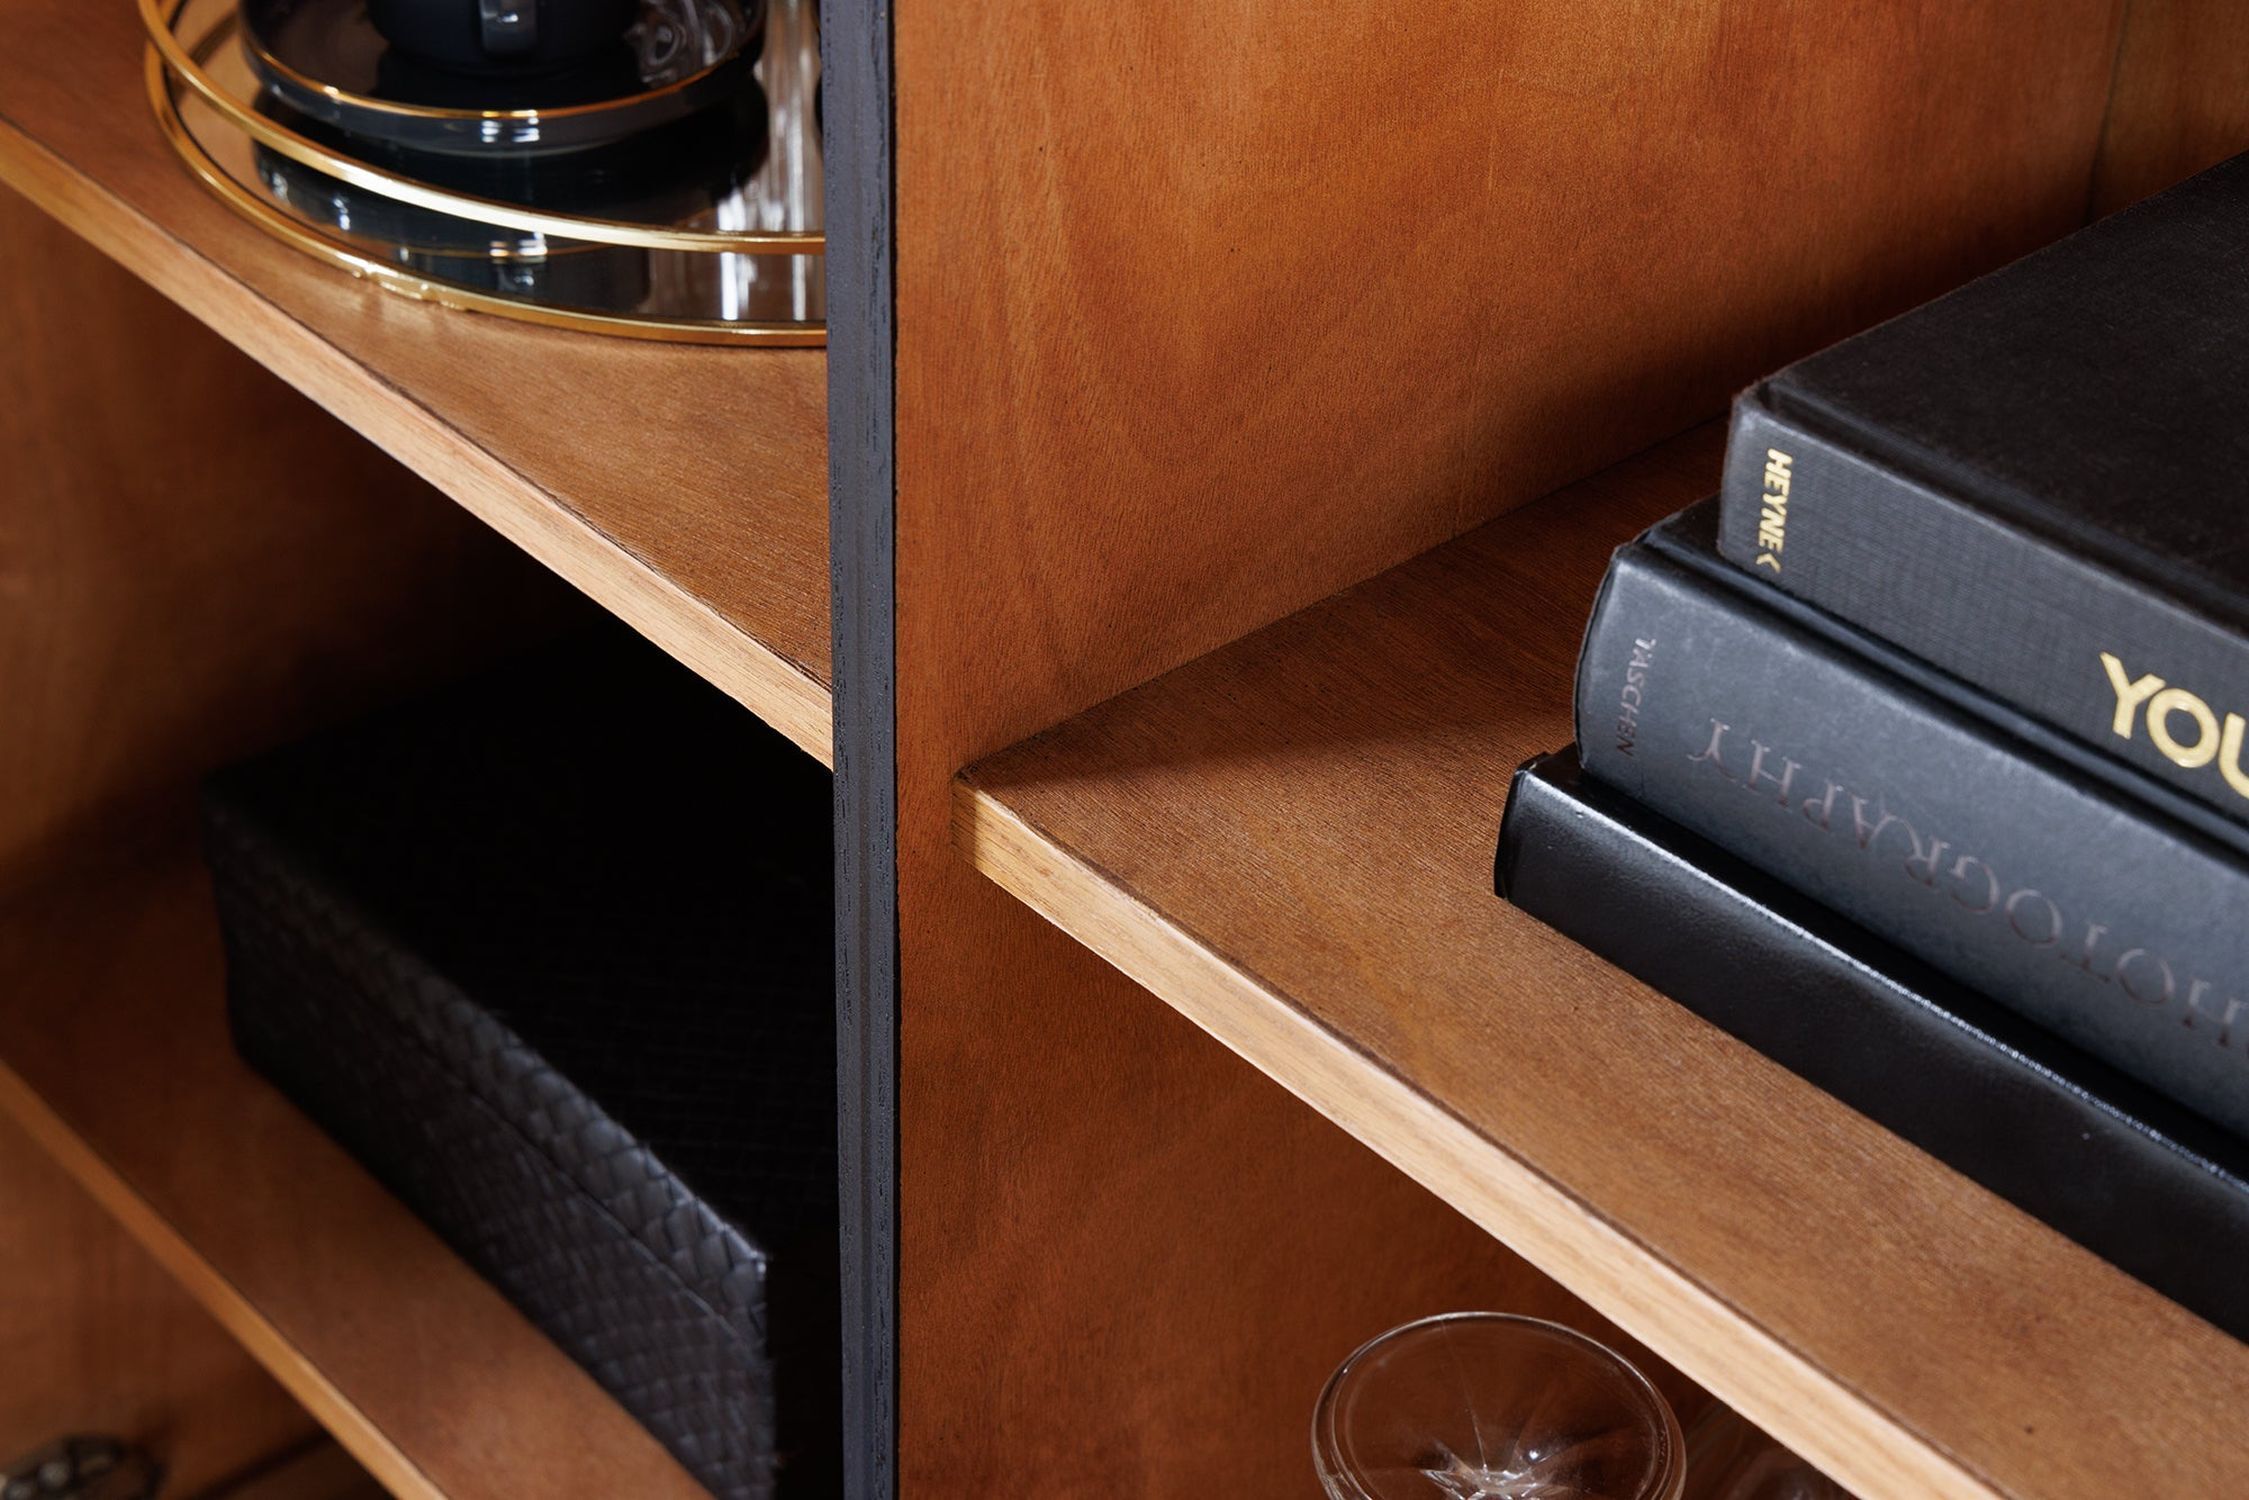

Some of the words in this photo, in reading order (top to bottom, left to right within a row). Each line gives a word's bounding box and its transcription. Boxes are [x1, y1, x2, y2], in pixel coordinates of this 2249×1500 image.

[1758, 448, 1793, 554] HEYNE
[1616, 638, 1656, 758] TASCHEN
[1686, 717, 2249, 1062] HOTOGRAPHY
